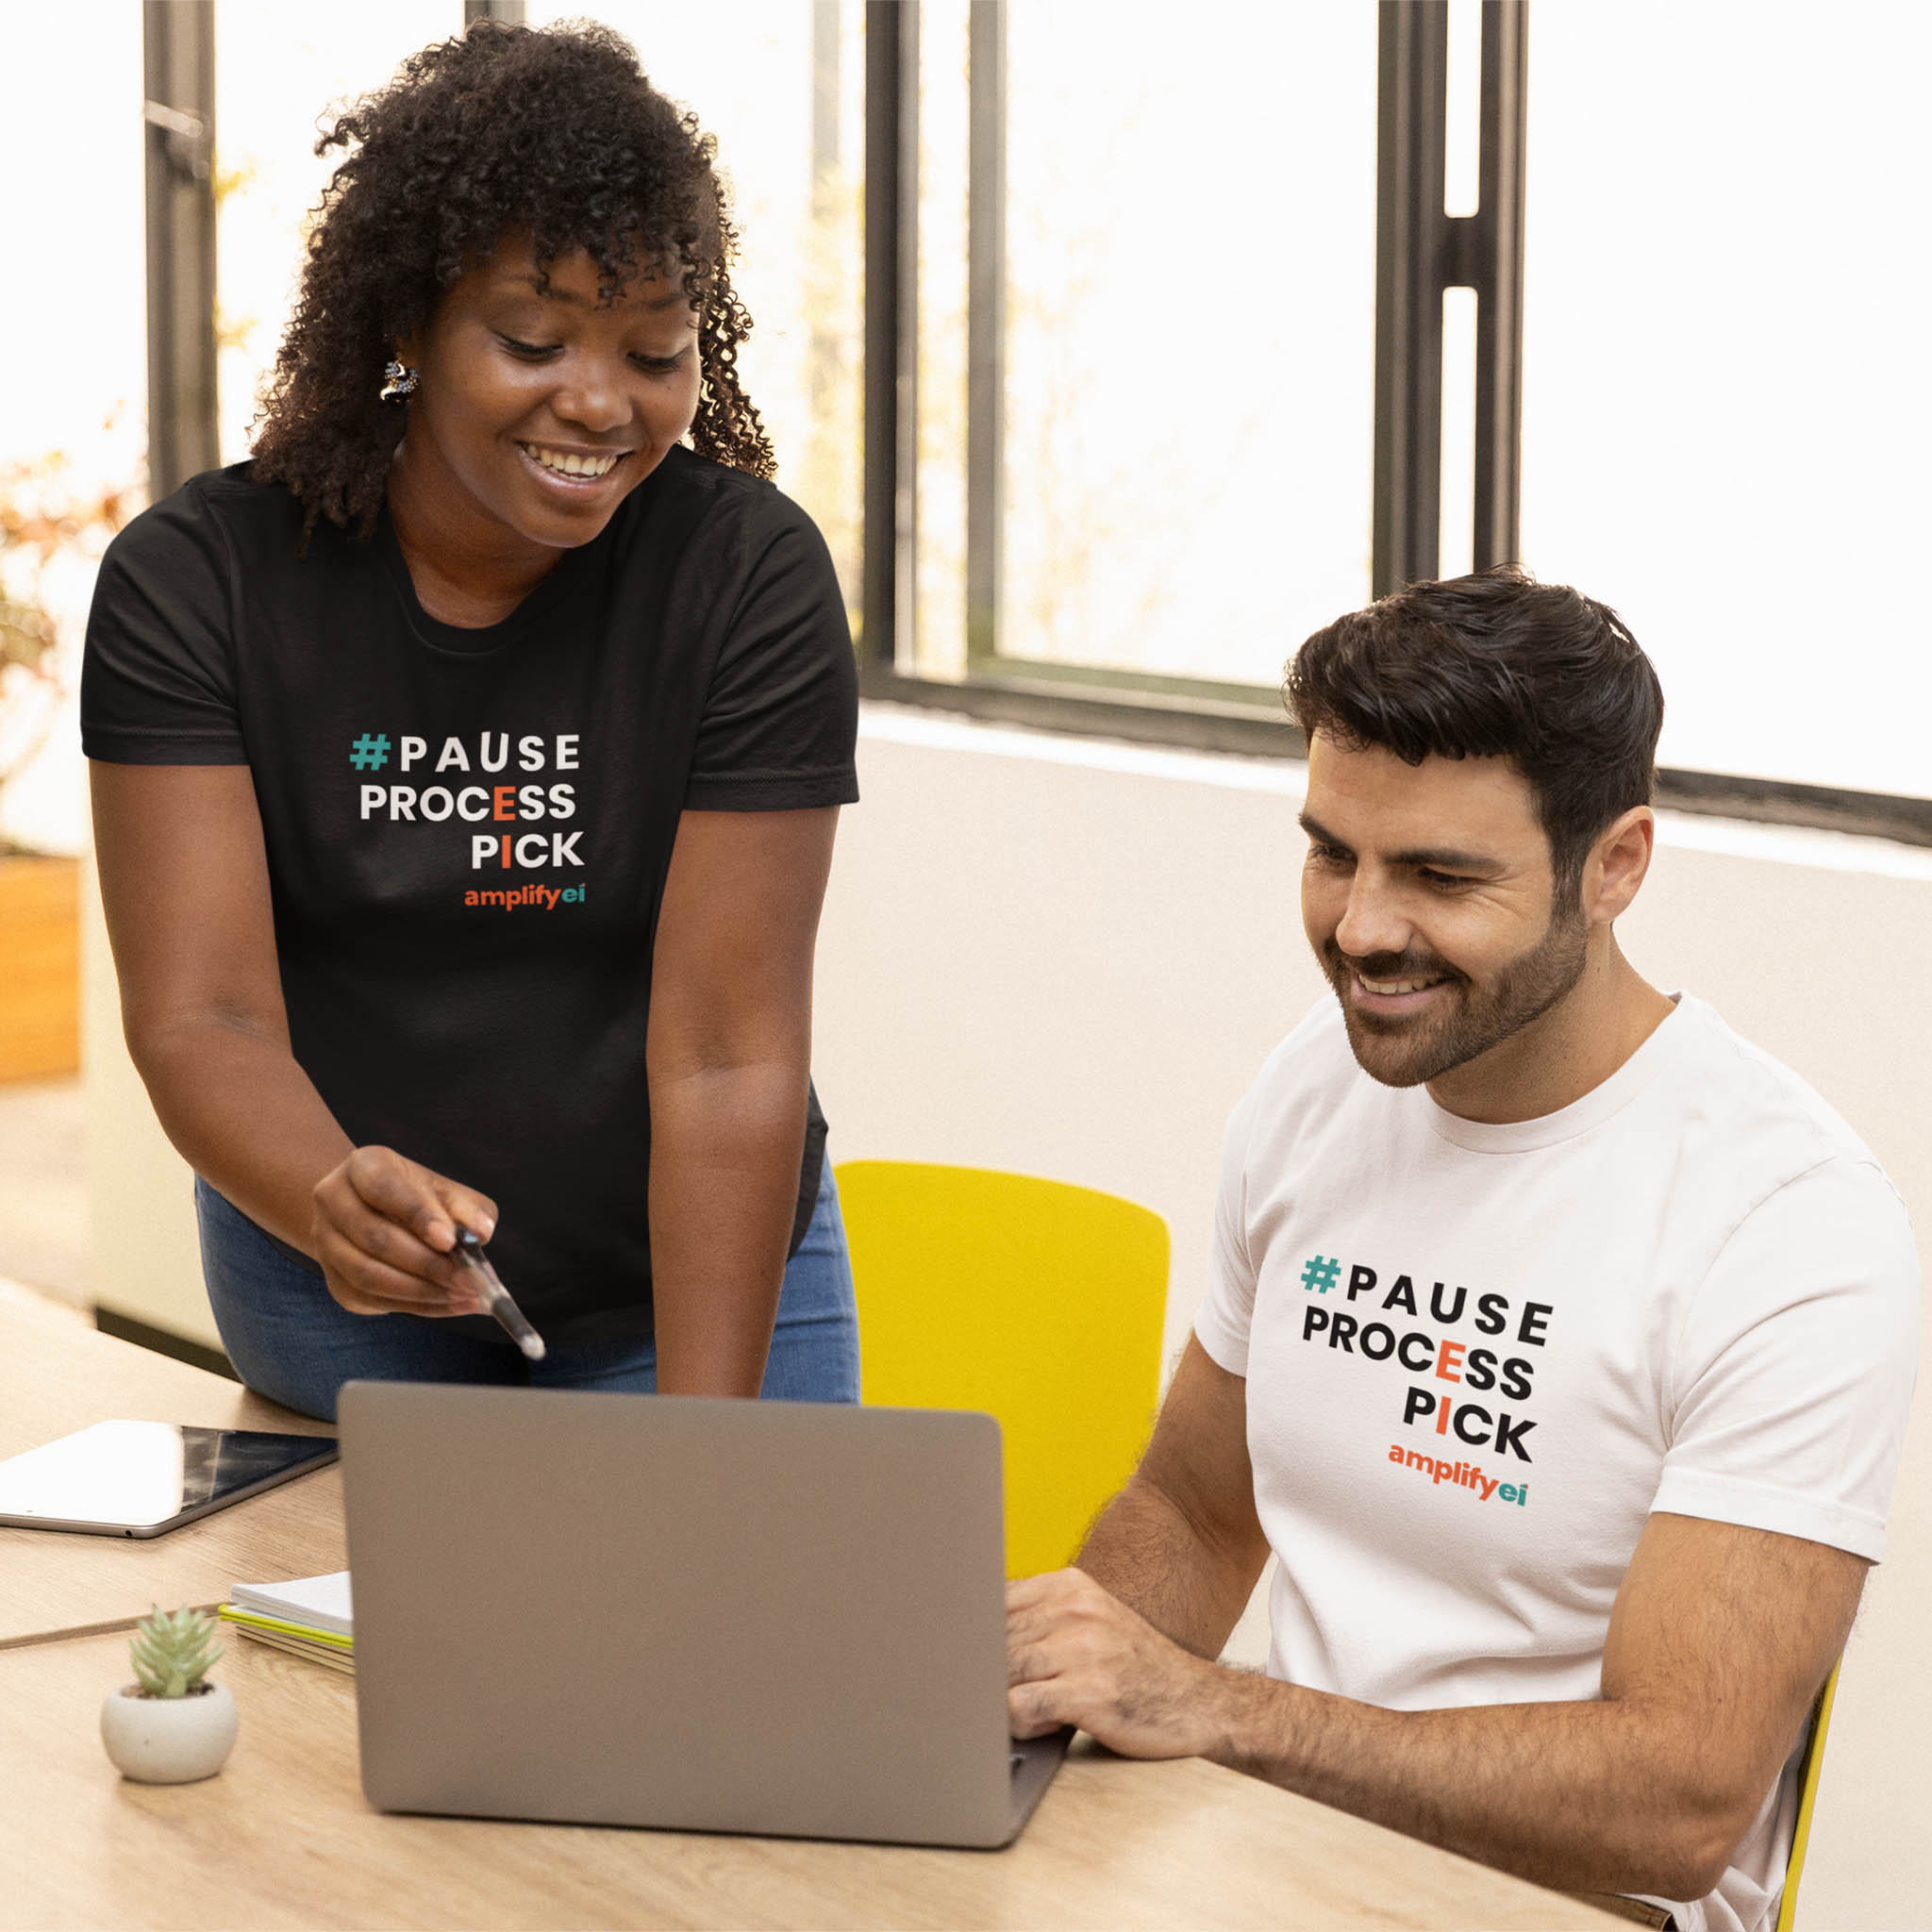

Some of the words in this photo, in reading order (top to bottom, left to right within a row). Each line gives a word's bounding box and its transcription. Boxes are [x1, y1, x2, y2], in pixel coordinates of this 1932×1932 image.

[349, 731, 580, 773] #PAUSE
[360, 784, 576, 822] PROCESS
[472, 831, 586, 869] PICK
[1300, 1255, 1554, 1347] #PAUSE
[1303, 1305, 1535, 1401] PROCESS
[1403, 1386, 1539, 1463] PICK
